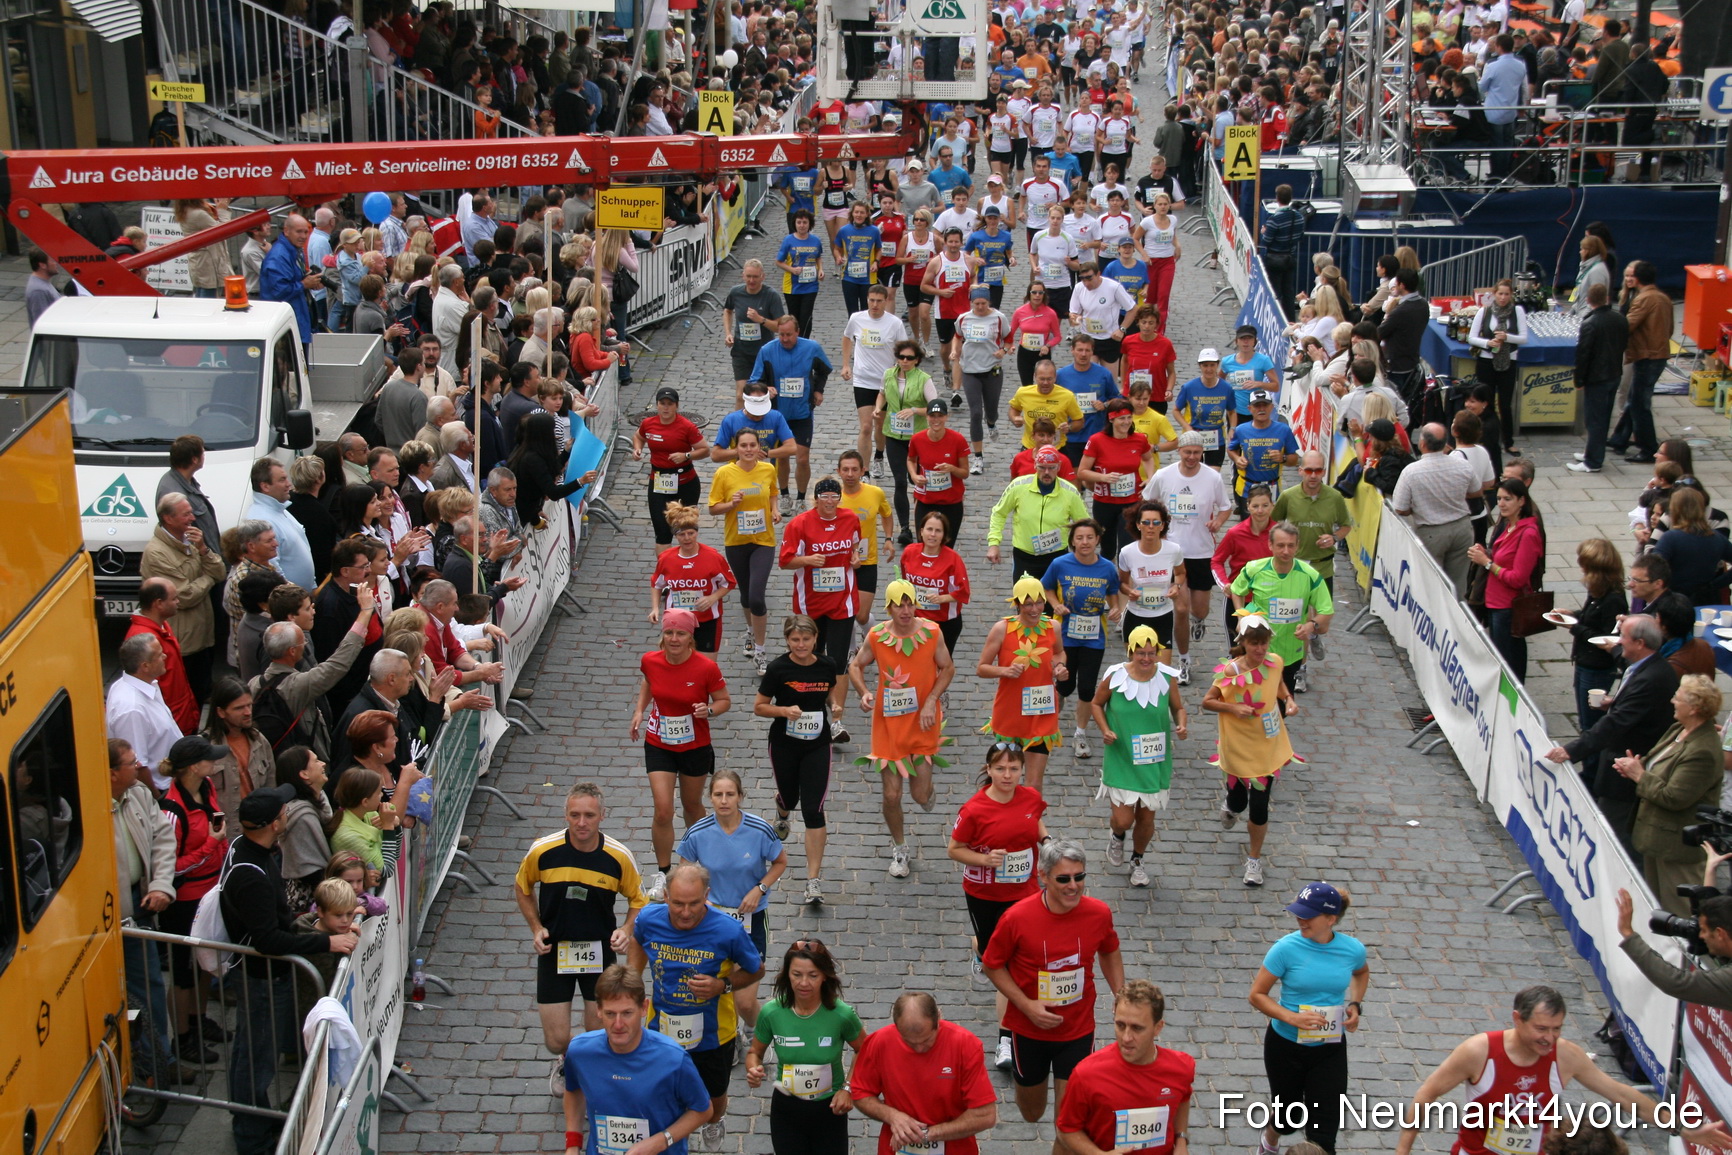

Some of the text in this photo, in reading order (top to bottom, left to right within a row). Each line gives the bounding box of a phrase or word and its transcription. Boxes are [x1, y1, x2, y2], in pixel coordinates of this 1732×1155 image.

[161, 84, 195, 94] Duschen
[163, 92, 194, 101] Freibad
[702, 93, 730, 103] Block
[705, 107, 726, 132] A
[1228, 127, 1257, 139] Block
[720, 148, 755, 163] 6352
[1232, 142, 1252, 169] A
[315, 152, 559, 176] Miet- & Serviceline: 09181 6352
[61, 163, 273, 185] Jura Gebäude Service
[600, 195, 660, 207] Schnupper-
[620, 208, 639, 219] lauf
[57, 254, 107, 264] RUTHMANN
[1550, 384, 1574, 394] Bier
[896, 421, 911, 429] 2248
[661, 480, 674, 488] 108
[932, 477, 949, 485] 3564
[1117, 481, 1134, 490] 3552
[1178, 503, 1196, 511] 6164
[812, 539, 852, 552] SYSCAD
[1041, 537, 1059, 548] 3346
[667, 578, 708, 588] SYSCAD
[822, 576, 842, 584] 2773
[905, 573, 945, 588] SYSCAD
[1145, 595, 1165, 603] 6015
[1278, 607, 1299, 616] 2240
[891, 697, 914, 707] 2872
[1032, 696, 1051, 705] 2468
[668, 725, 690, 735] 3515
[797, 722, 819, 730] 3109
[1143, 743, 1163, 754] 2740
[1514, 728, 1596, 900] BOCK
[1007, 861, 1030, 873] 2369
[569, 941, 591, 949] Jürgen
[650, 941, 715, 959] 10. NEUMARKTER
[574, 951, 596, 962] 145
[657, 951, 702, 965] STADTLAUF
[1051, 973, 1077, 982] Raimund
[1056, 983, 1078, 995] 309
[376, 980, 401, 1038] Neumark
[668, 1018, 681, 1026] Toni
[677, 1029, 692, 1039] 68
[1706, 1024, 1732, 1068] Auftra
[795, 1068, 813, 1076] Maria
[805, 1078, 820, 1089] 67
[610, 1120, 637, 1129] Gerhard
[1131, 1122, 1162, 1135] 3840
[611, 1132, 643, 1144] 3345
[1506, 1137, 1532, 1149] 972
